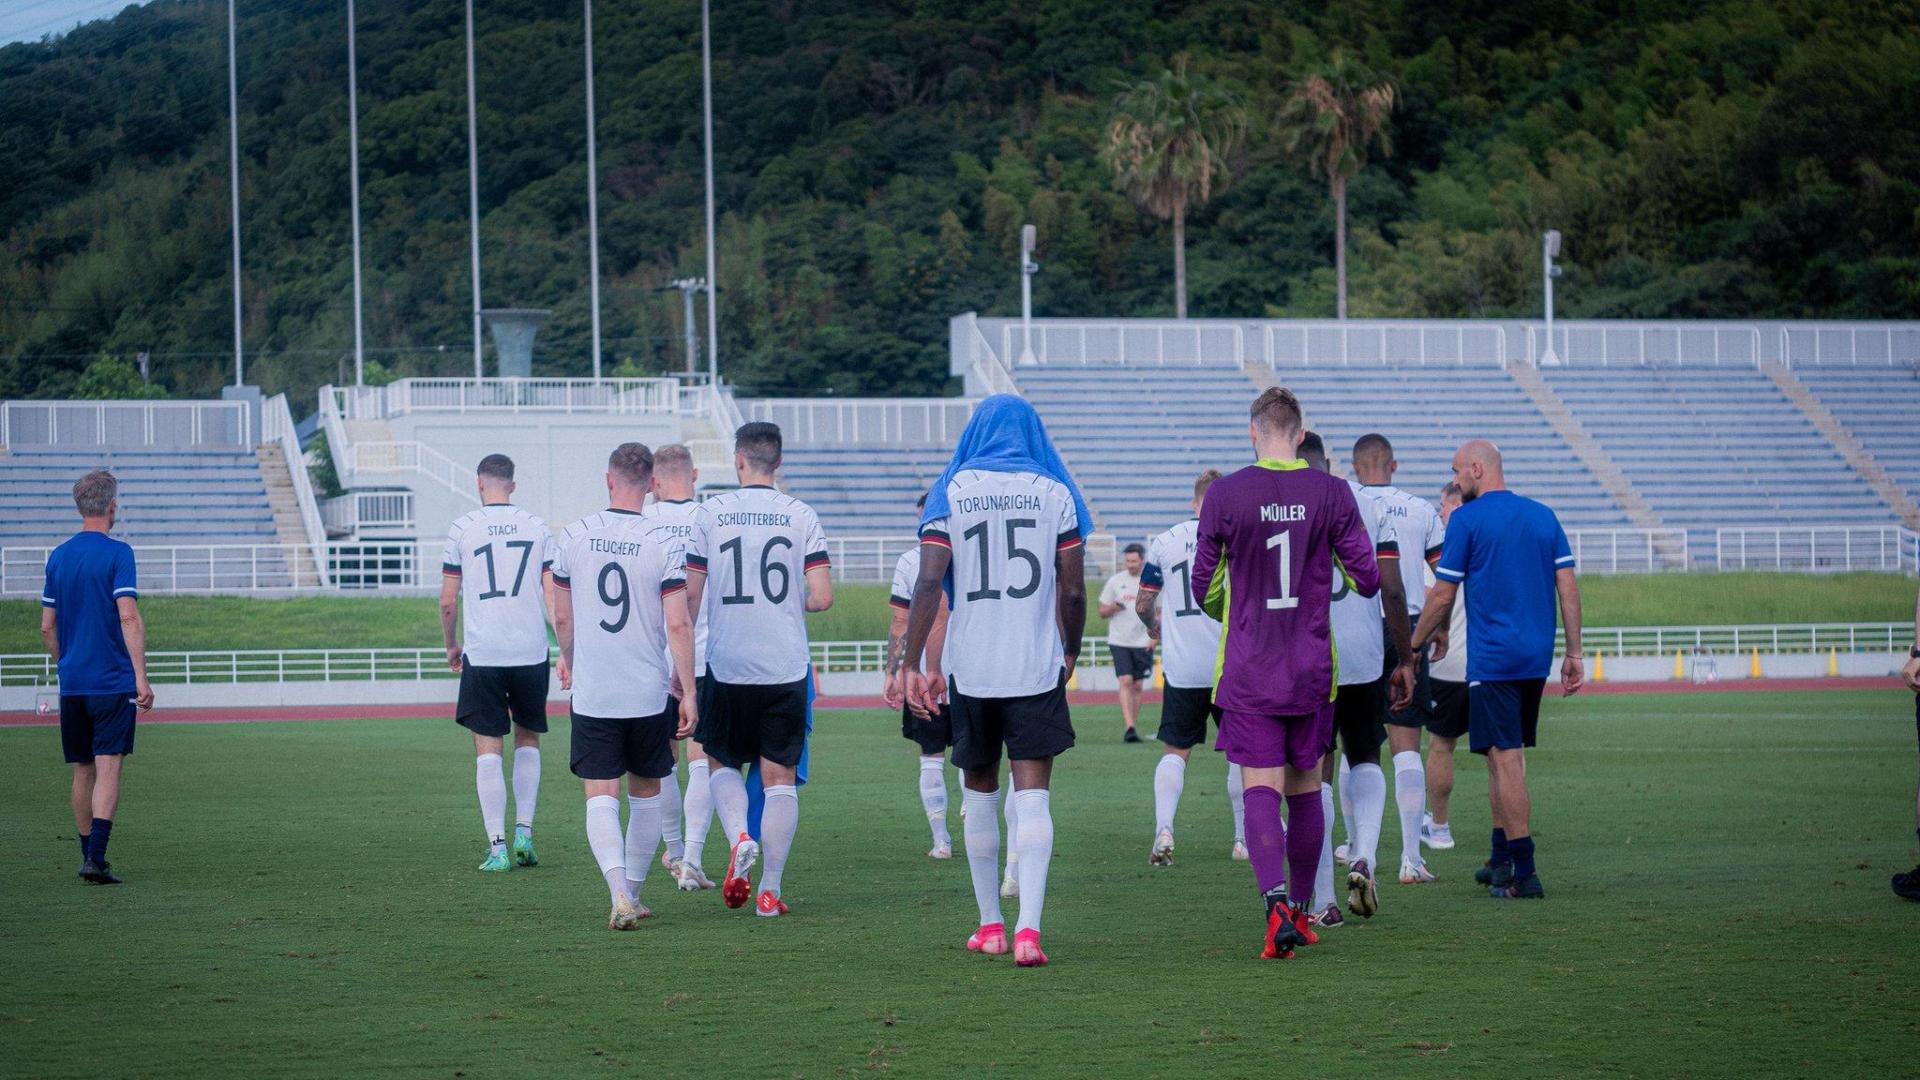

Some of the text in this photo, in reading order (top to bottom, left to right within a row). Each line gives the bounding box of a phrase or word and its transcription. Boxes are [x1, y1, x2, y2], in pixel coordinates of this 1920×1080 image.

[487, 523, 518, 536] STACH
[717, 512, 793, 528] SCHLOTTERBECK
[957, 494, 1041, 514] TORUNARIGHA
[1260, 503, 1306, 522] MÜLLER
[473, 540, 535, 601] 17
[589, 538, 642, 557] TEUCHERT
[719, 535, 793, 605] 16
[963, 518, 1042, 602] 15
[1266, 529, 1300, 610] 1
[597, 561, 631, 634] 9
[1171, 559, 1202, 618] 1
